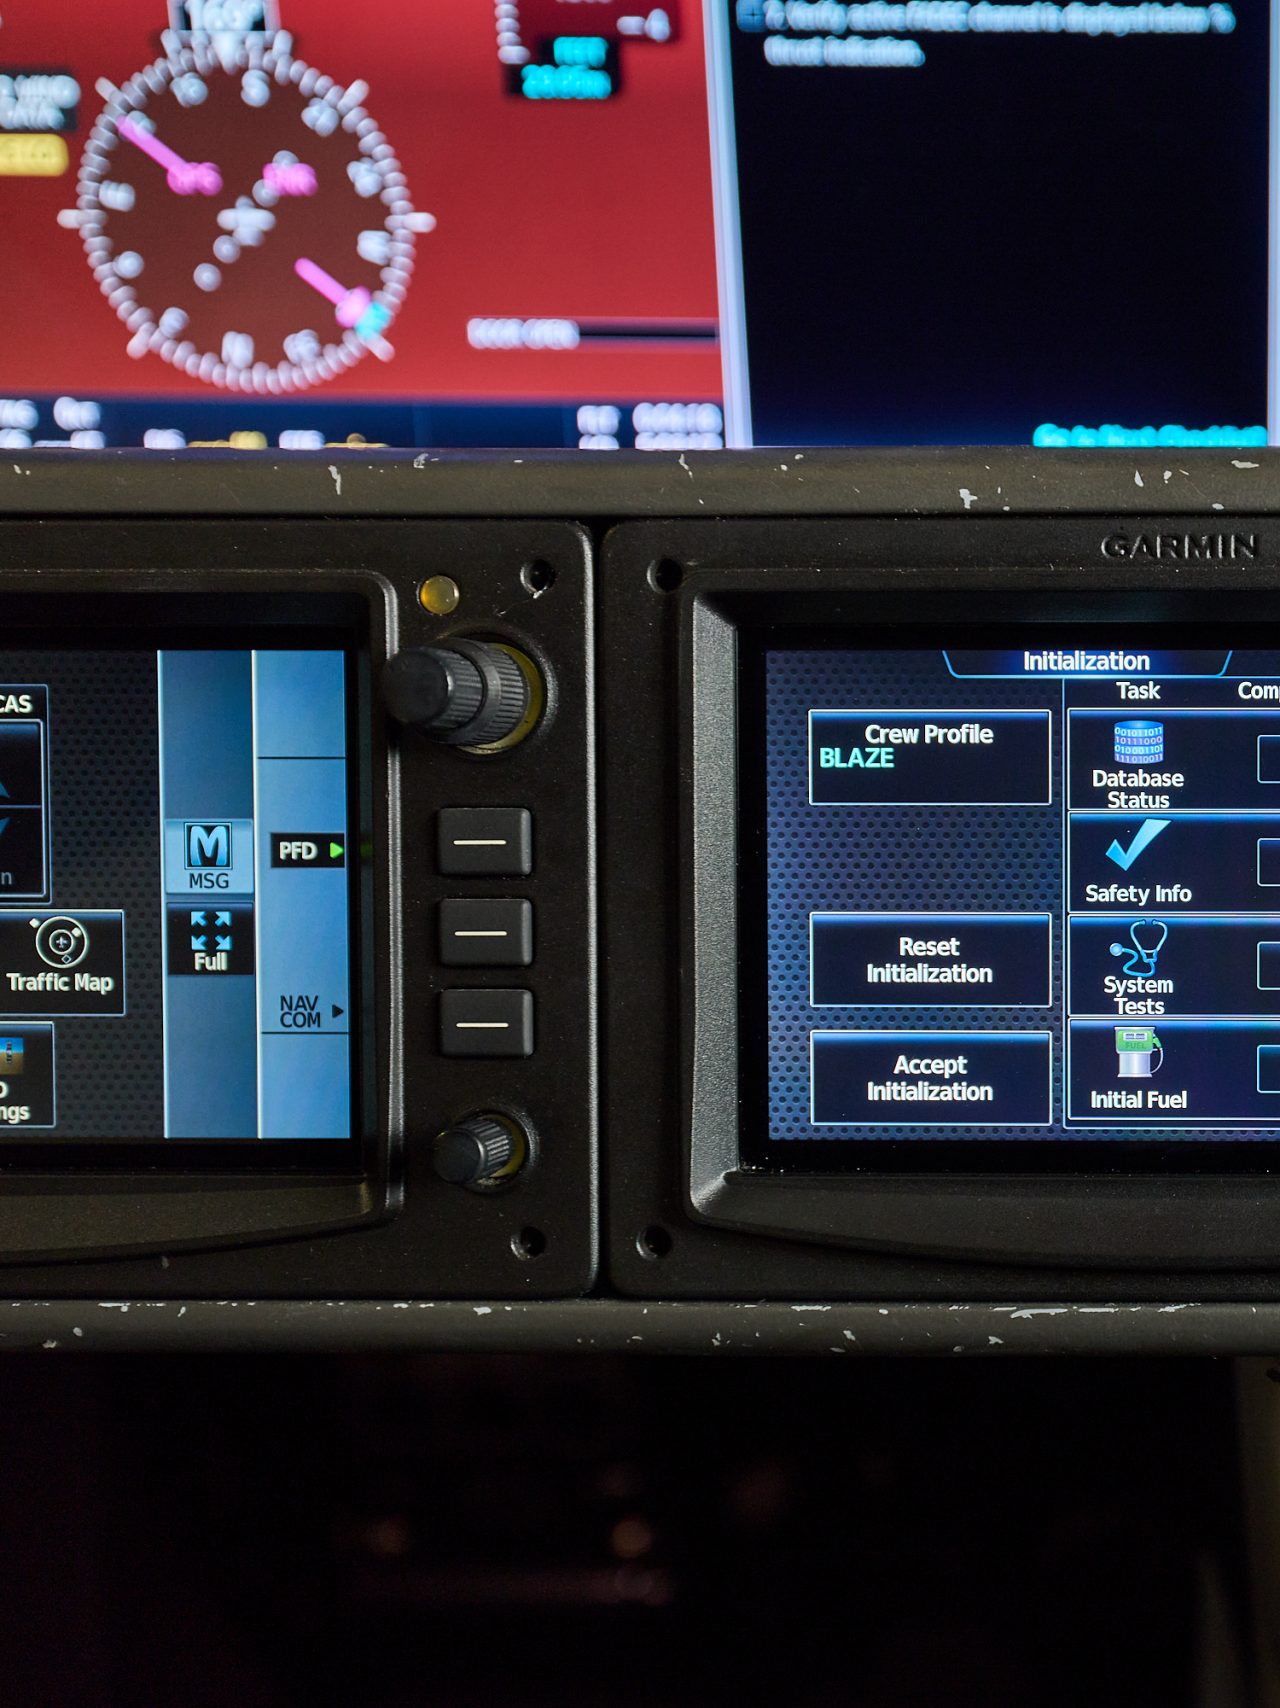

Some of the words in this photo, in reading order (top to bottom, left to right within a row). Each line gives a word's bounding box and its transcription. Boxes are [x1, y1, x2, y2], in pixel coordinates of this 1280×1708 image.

[1100, 533, 1258, 560] GARMIN
[1023, 651, 1151, 672] Initialization
[1116, 682, 1161, 701] Task
[865, 725, 920, 745] Crew
[924, 724, 994, 744] Profile
[819, 748, 895, 769] BLAZE
[1092, 768, 1185, 788] Database
[1107, 791, 1170, 809] Status
[279, 841, 318, 860] PFD
[188, 872, 230, 890] MSG
[1085, 884, 1150, 906] Safety
[1155, 884, 1193, 903] Info
[899, 937, 960, 957] Reset
[194, 953, 228, 972] Full
[6, 972, 71, 993] Traffic
[74, 972, 115, 995] Map
[866, 964, 993, 984] Initialization
[1103, 976, 1174, 997] System
[280, 994, 319, 1012] NAV
[1113, 997, 1165, 1015] Tests
[280, 1011, 322, 1029] COM
[1125, 1042, 1147, 1050] FUEL
[893, 1055, 968, 1078] Accept
[867, 1082, 994, 1102] Initialization
[1090, 1090, 1143, 1109] Initial
[1147, 1090, 1188, 1109] Fuel
